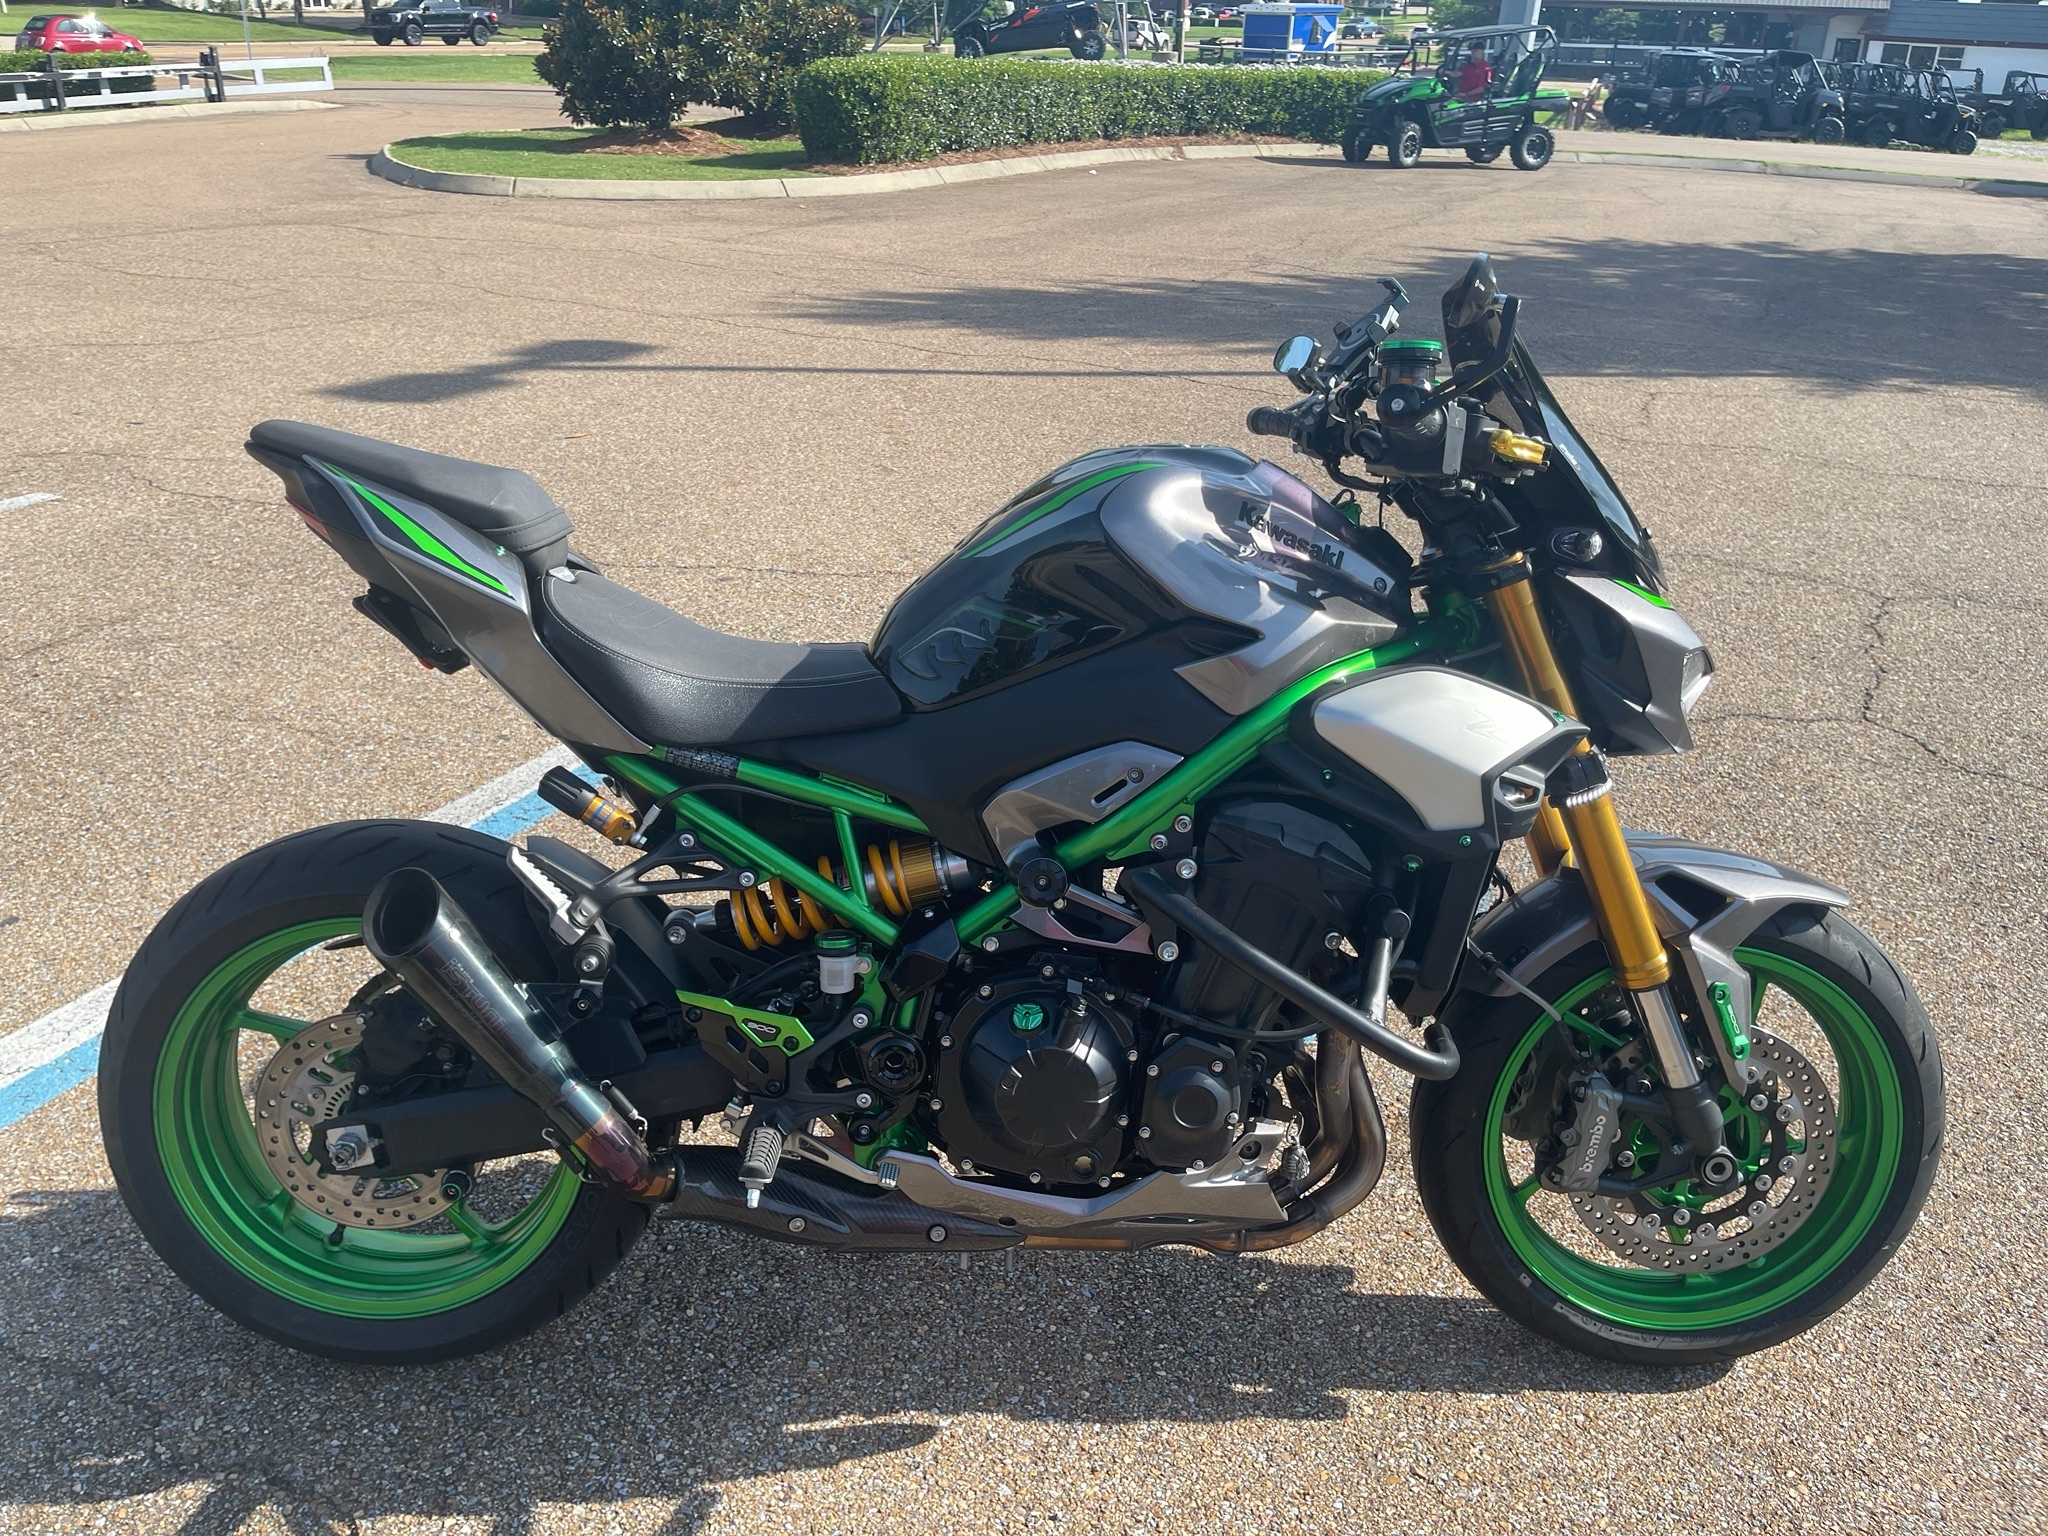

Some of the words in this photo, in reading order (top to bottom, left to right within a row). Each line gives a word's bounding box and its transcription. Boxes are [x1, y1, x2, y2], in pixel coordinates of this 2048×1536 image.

[1238, 501, 1344, 570] Kawasaki
[747, 1021, 776, 1034] 900
[1727, 1004, 1740, 1034] 900
[1578, 1115, 1606, 1173] brembo
